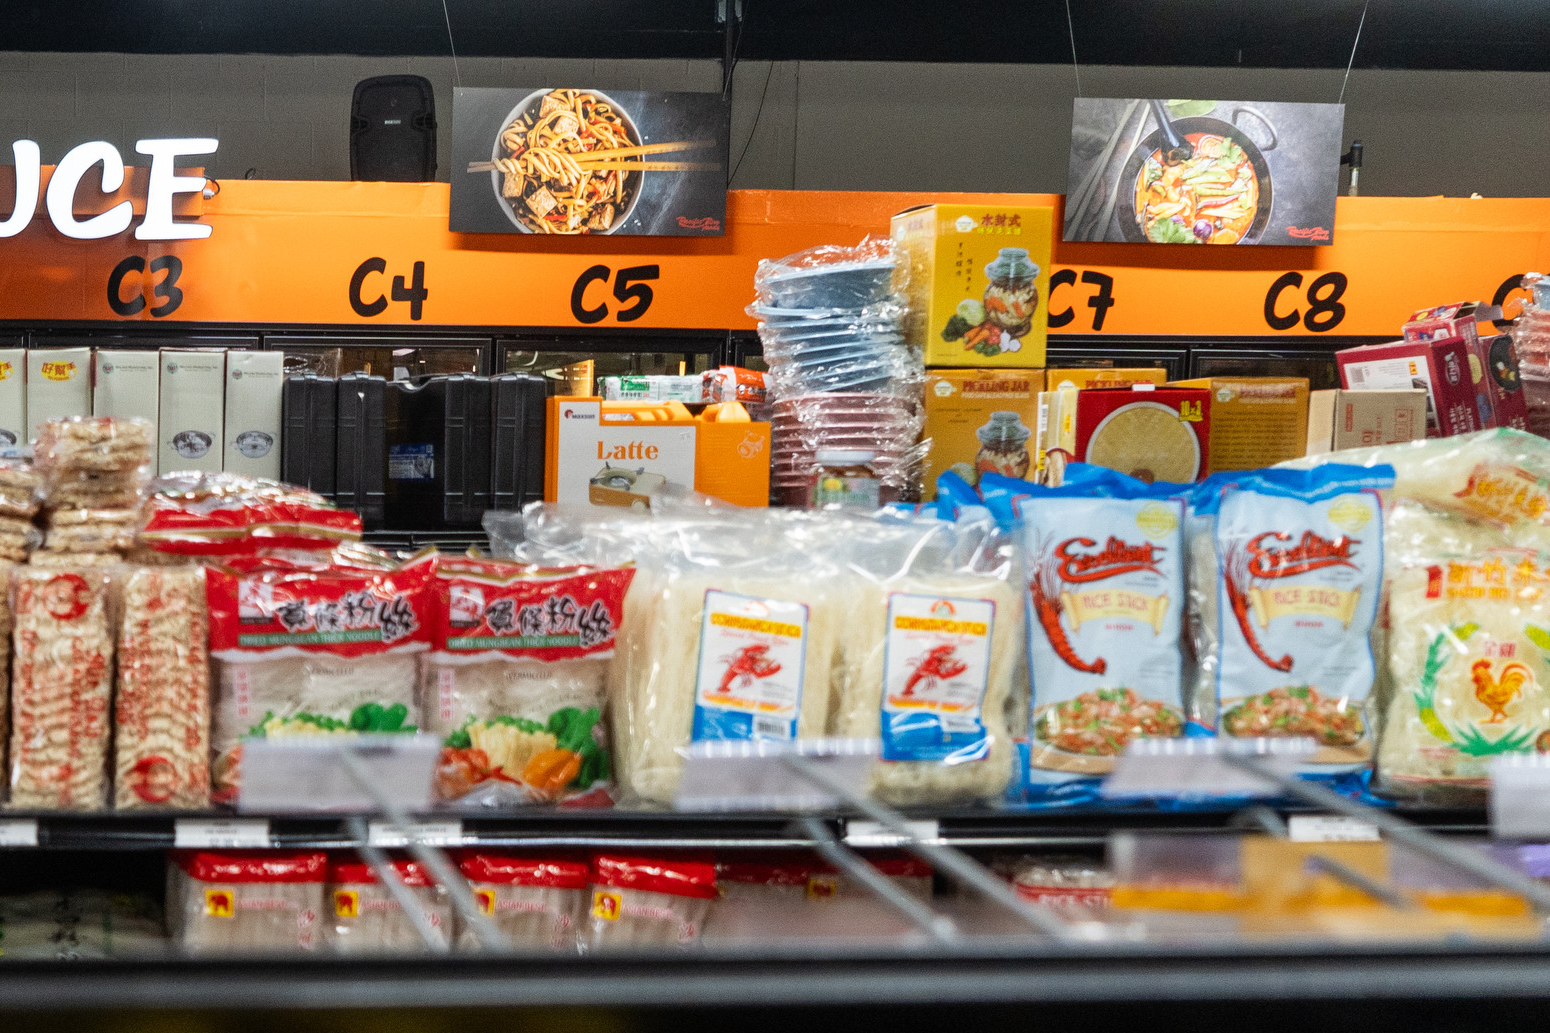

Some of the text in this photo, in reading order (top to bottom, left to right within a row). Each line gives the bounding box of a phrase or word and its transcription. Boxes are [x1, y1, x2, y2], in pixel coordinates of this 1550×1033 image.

[107, 255, 183, 316] C3
[349, 257, 428, 321] C4
[570, 265, 659, 323] C5
[1047, 269, 1115, 331] C7
[1264, 272, 1348, 332] C8
[1011, 381, 1030, 392] JAR
[597, 441, 659, 460] Latte
